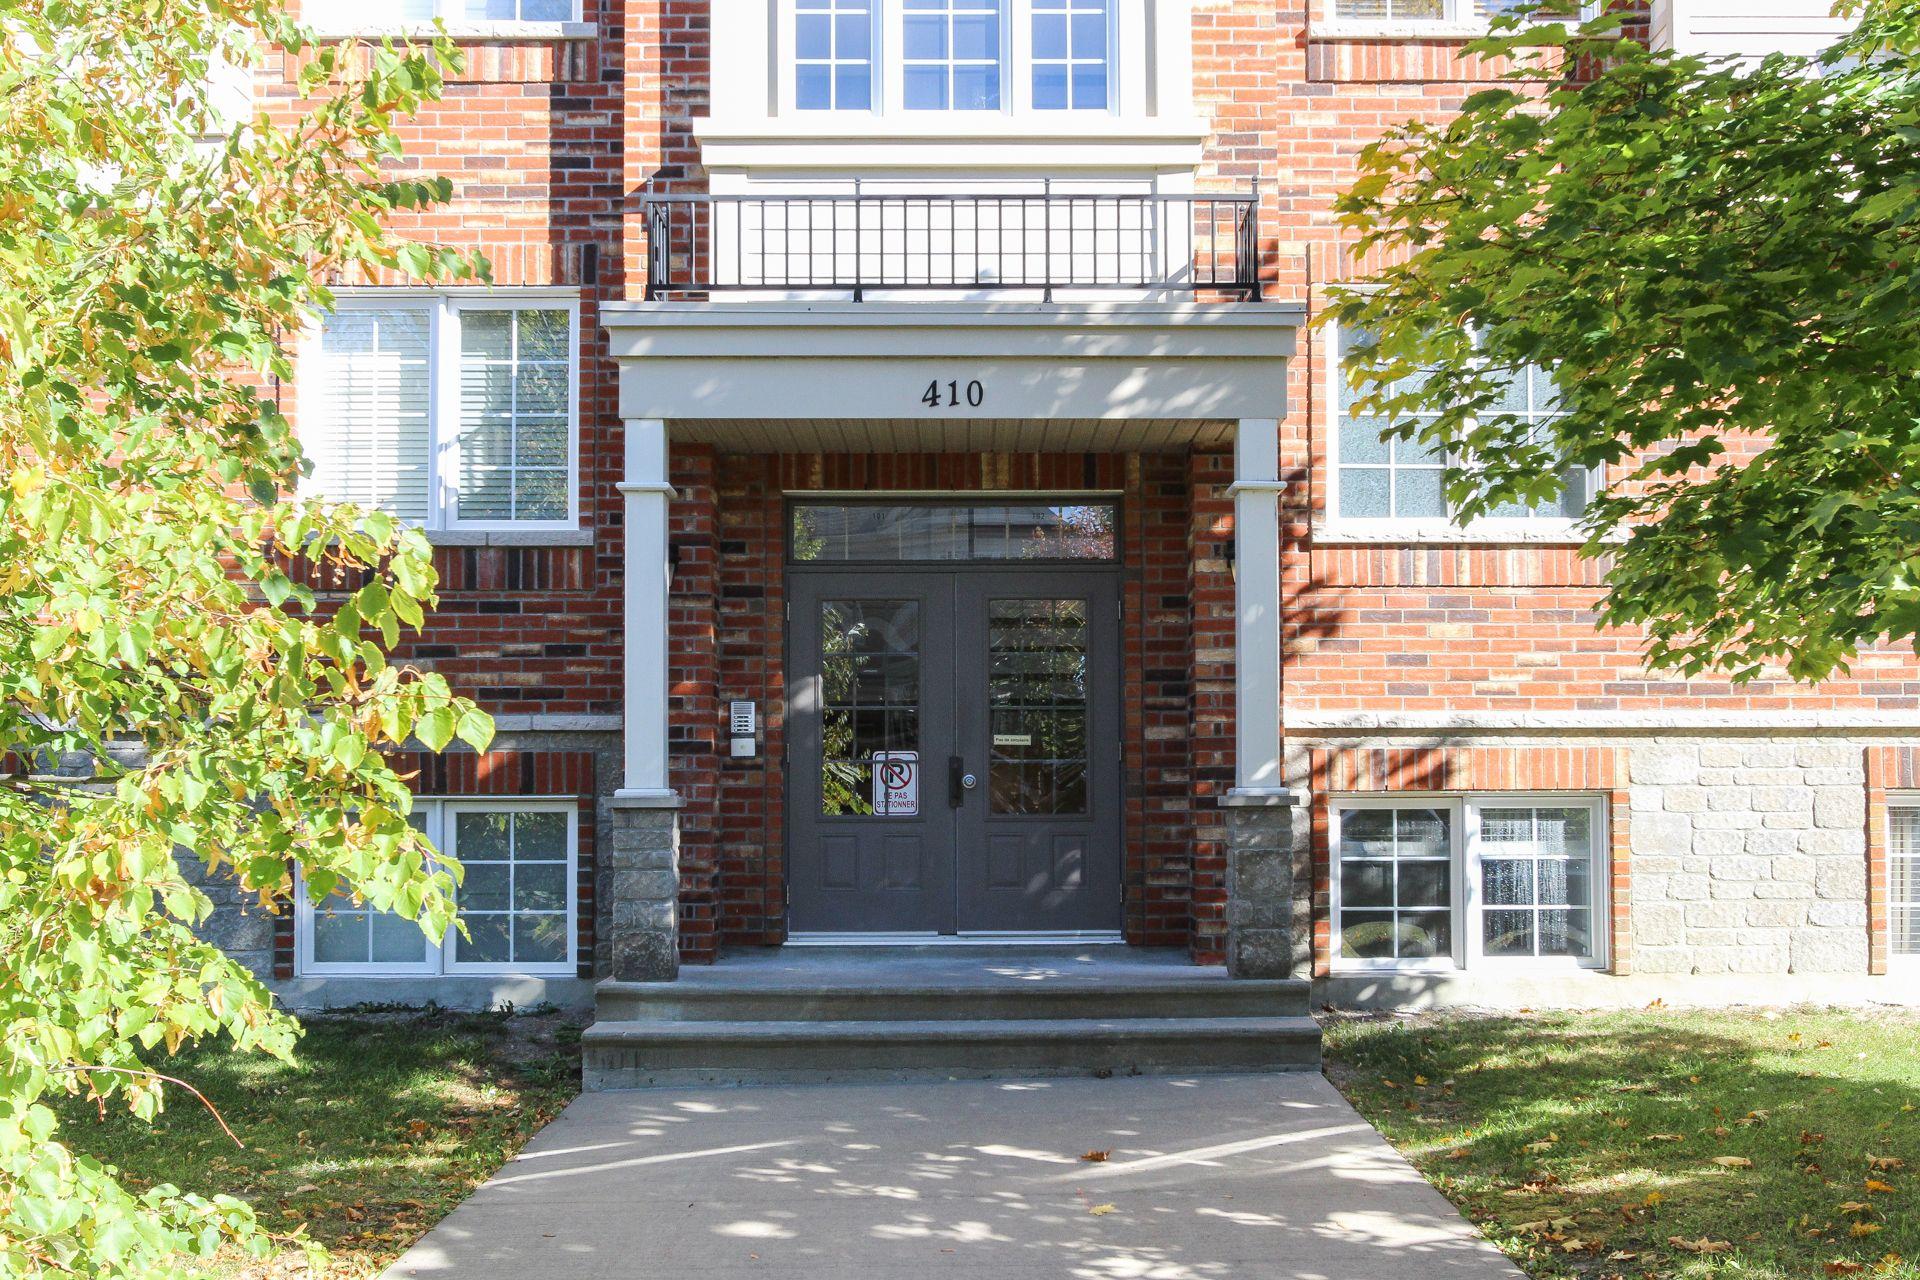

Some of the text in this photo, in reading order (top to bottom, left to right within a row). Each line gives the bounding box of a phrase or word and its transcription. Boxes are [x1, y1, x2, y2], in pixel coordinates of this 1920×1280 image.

[921, 379, 984, 408] 410
[894, 791, 908, 800] PAS
[876, 800, 915, 808] STTIONNER
